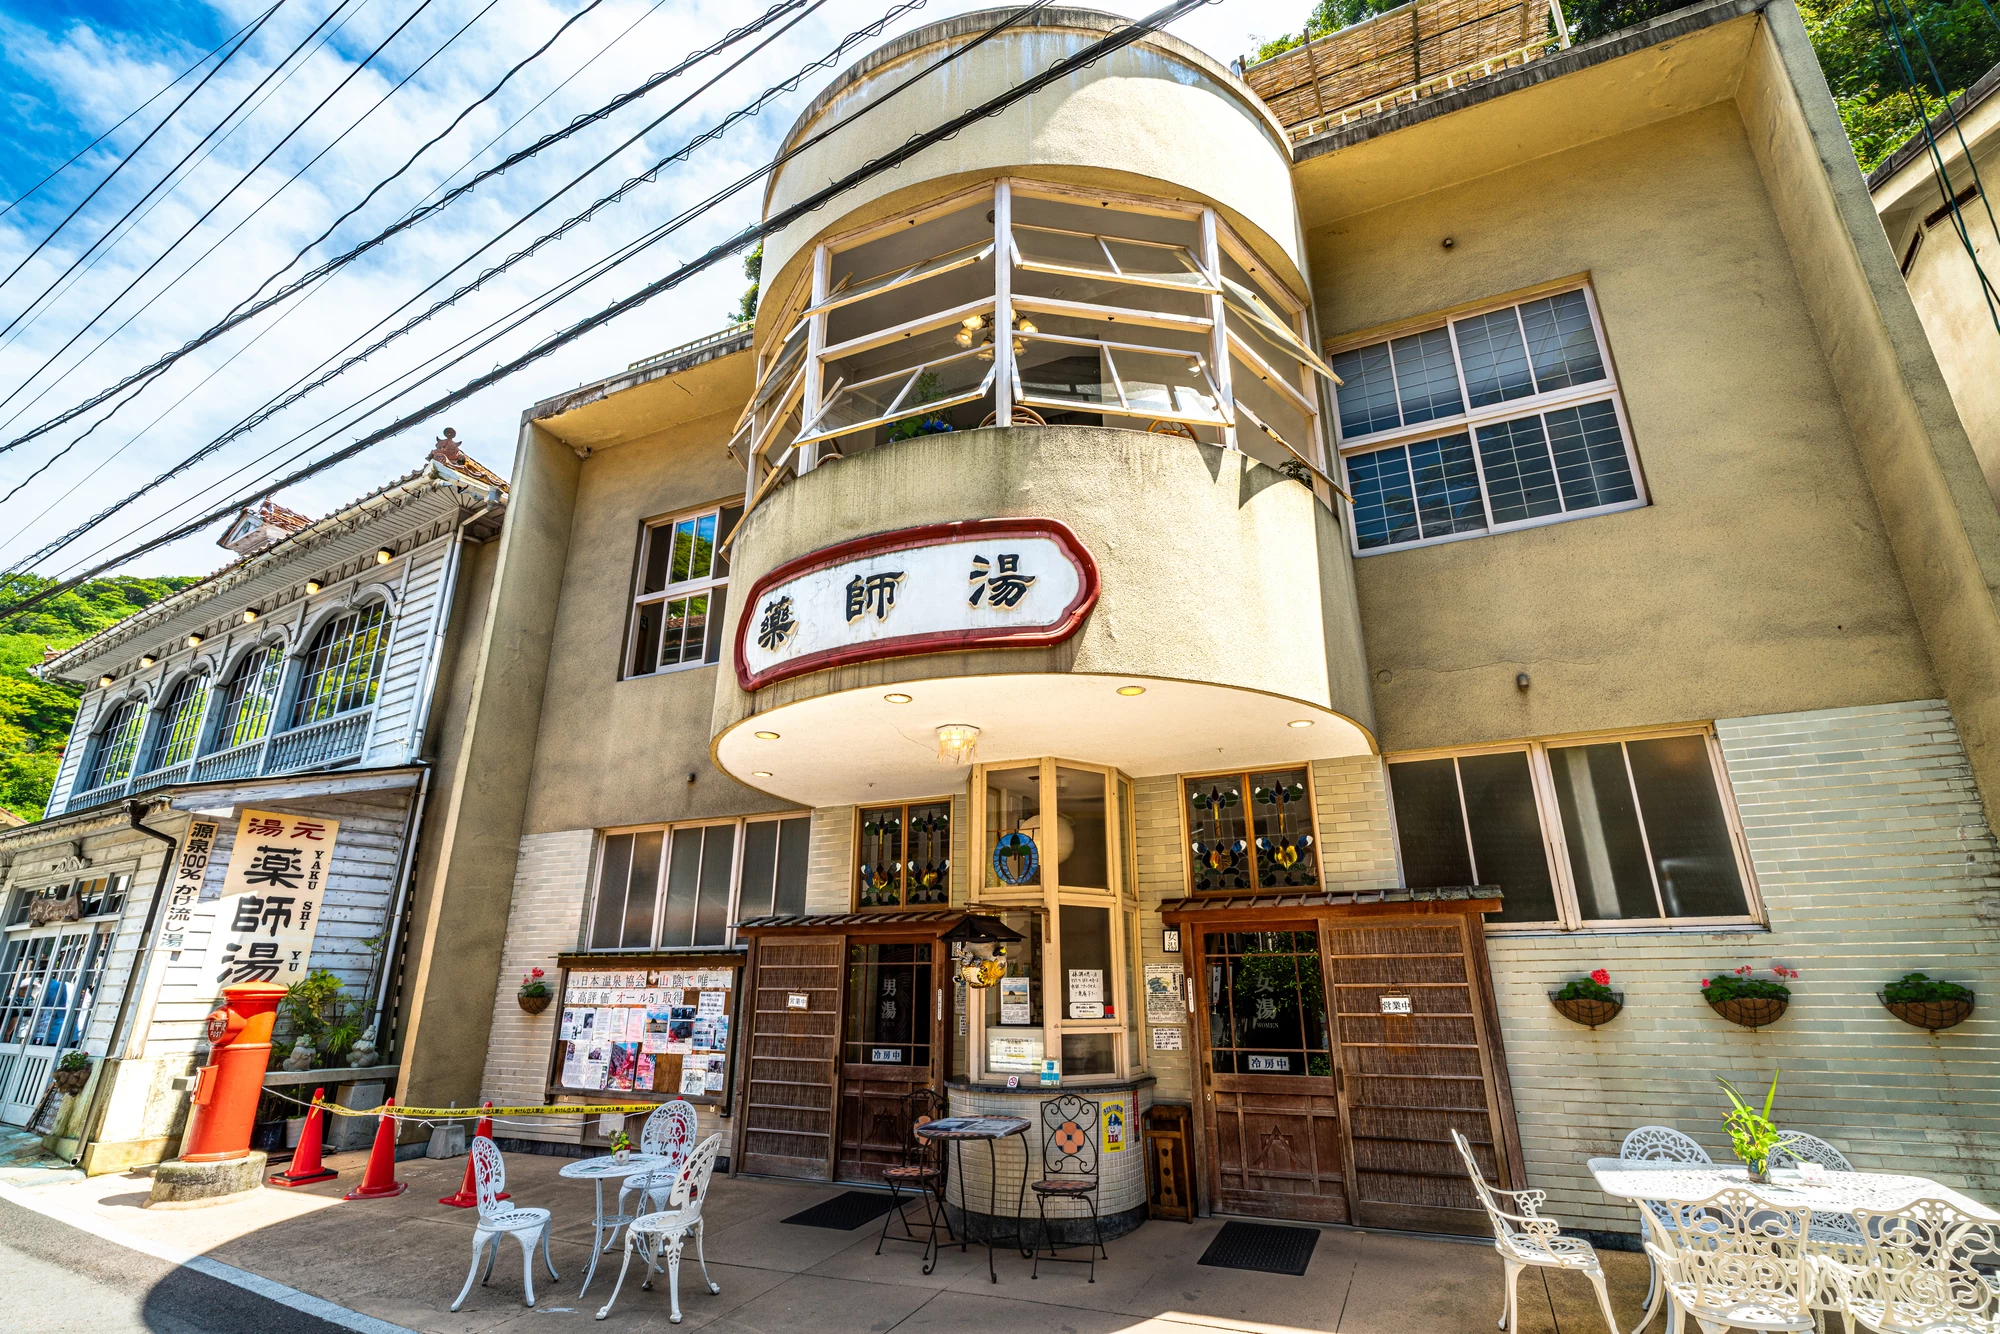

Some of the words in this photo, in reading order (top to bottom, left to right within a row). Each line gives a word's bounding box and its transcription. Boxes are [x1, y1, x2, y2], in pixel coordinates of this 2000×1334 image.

[247, 818, 326, 841] 湯元
[307, 850, 325, 891] YAKU
[216, 845, 305, 984] 薬師湯
[299, 901, 313, 931] SHI
[1168, 931, 1177, 951] 女湯
[288, 951, 302, 972] YU
[881, 978, 897, 1020] 男湯
[1254, 971, 1278, 1020] 女湯
[1382, 1000, 1410, 1010] 営業中
[873, 1050, 900, 1060] 冷房中
[1251, 1057, 1288, 1069] 冷房中
